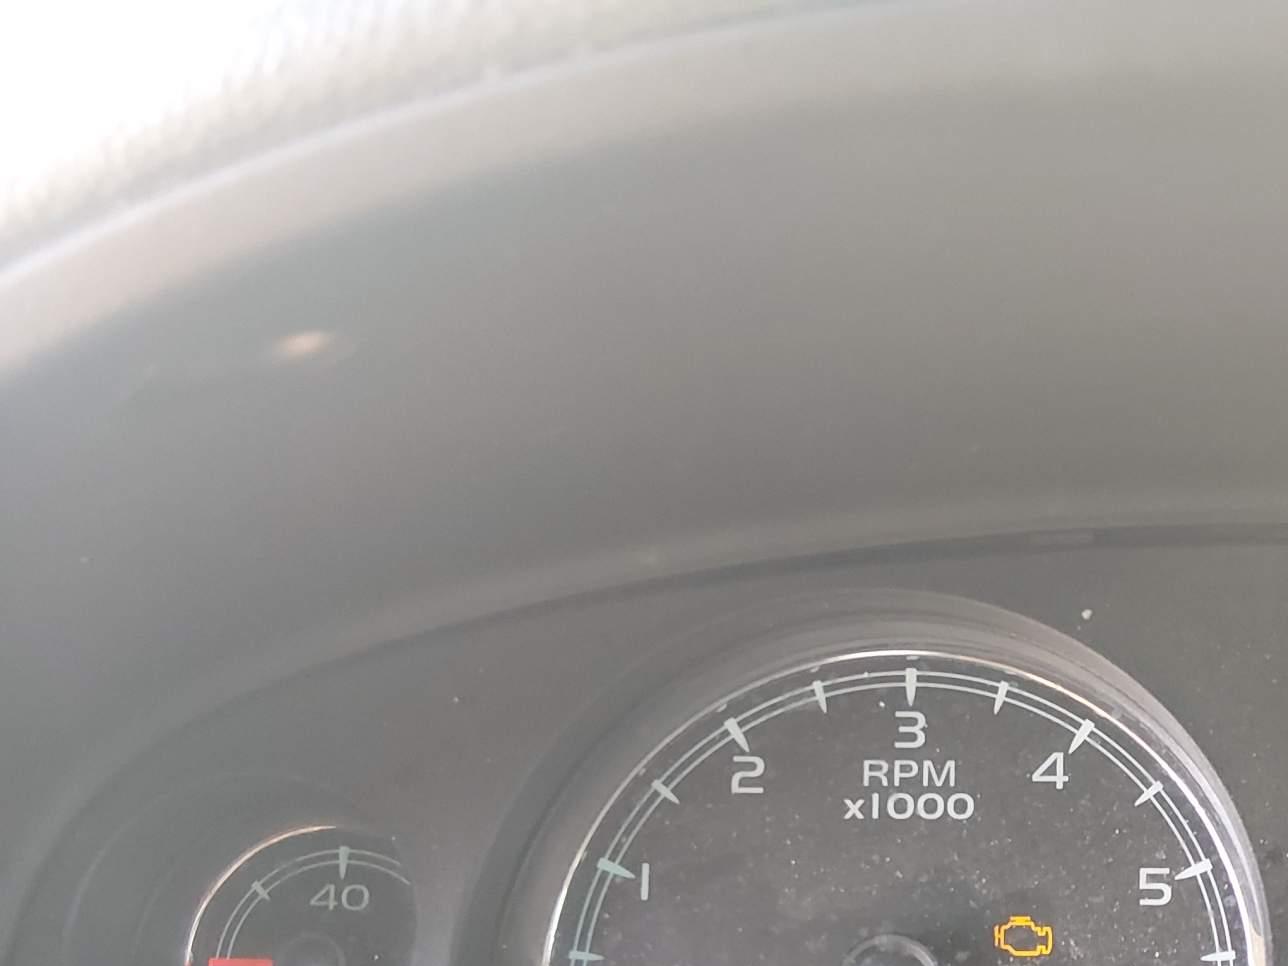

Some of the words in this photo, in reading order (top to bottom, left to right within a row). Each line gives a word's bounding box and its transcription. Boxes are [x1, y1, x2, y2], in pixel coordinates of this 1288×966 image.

[895, 711, 926, 749] 3
[731, 756, 766, 795] 2
[863, 760, 956, 786] RPM
[1032, 752, 1068, 789] 4
[843, 794, 975, 821] x1000
[309, 884, 369, 911] 40
[641, 863, 650, 899] 1
[1139, 867, 1173, 906] 5
